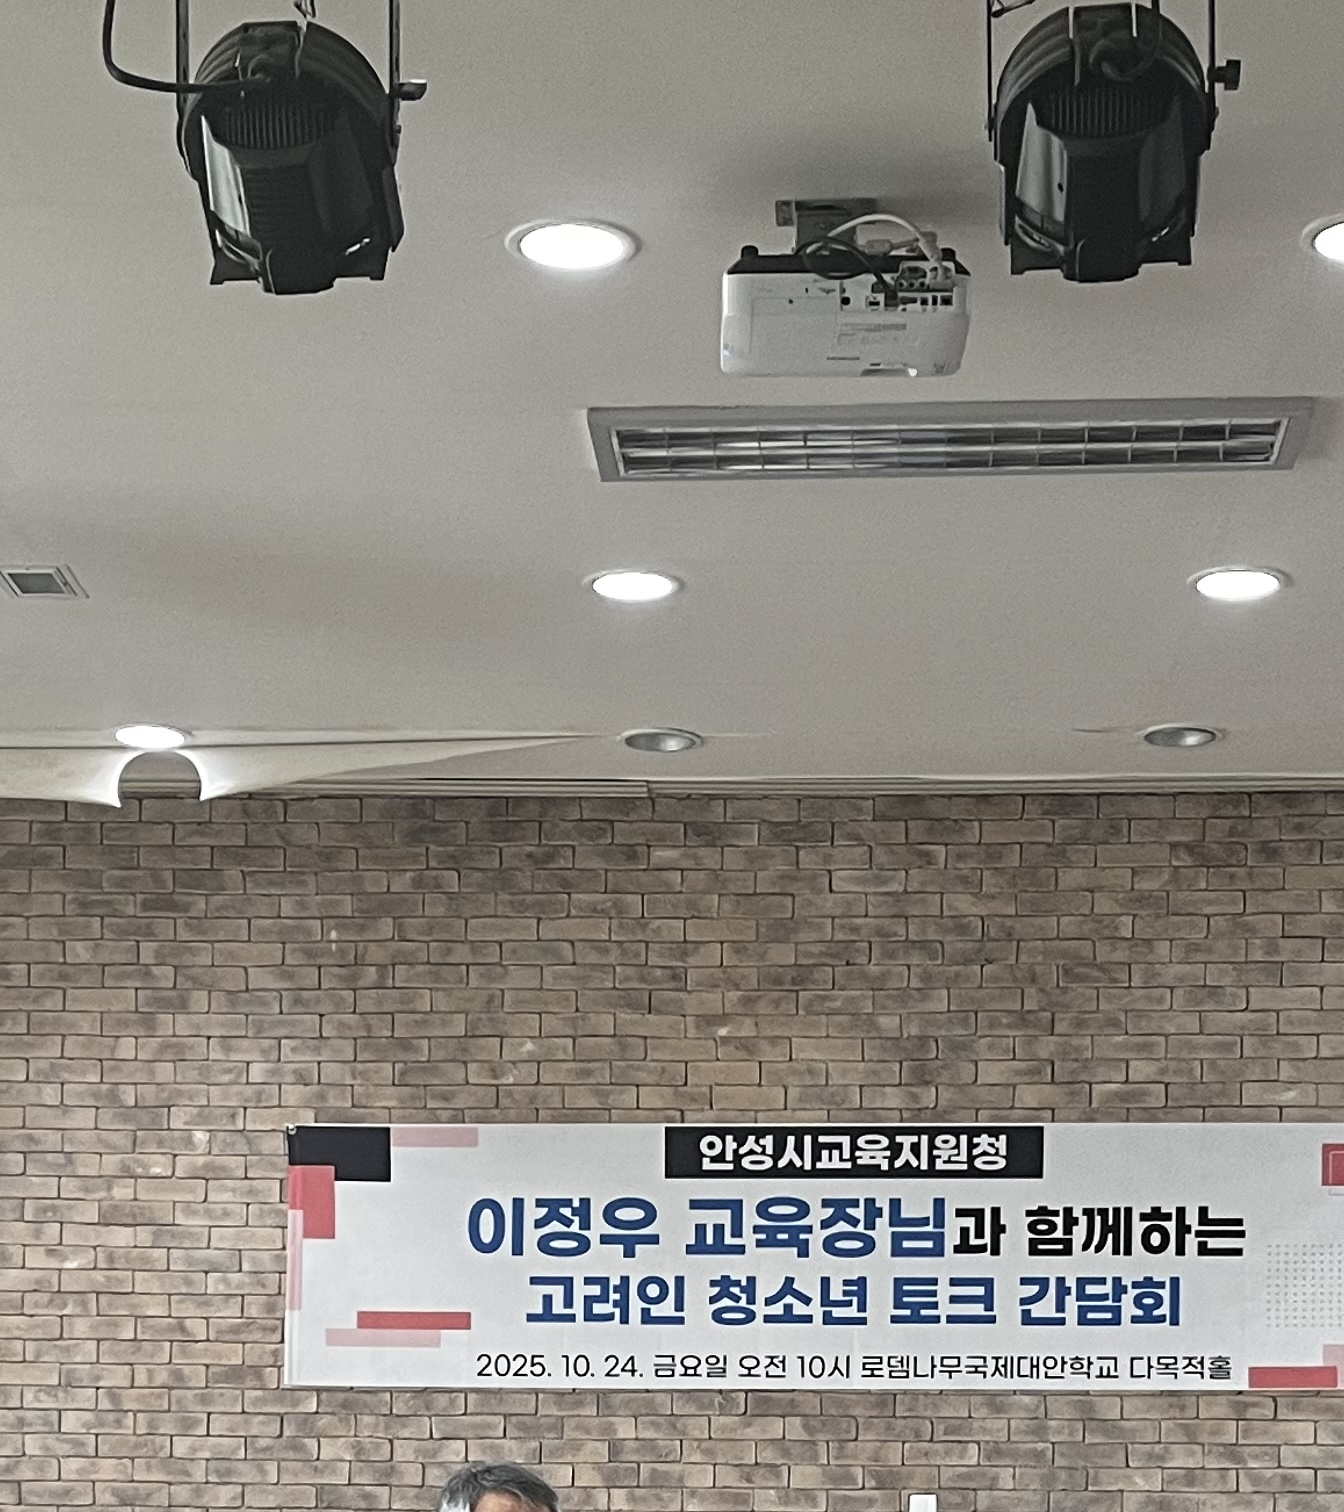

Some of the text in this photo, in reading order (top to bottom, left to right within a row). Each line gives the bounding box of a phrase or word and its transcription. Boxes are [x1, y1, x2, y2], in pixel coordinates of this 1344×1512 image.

[699, 1133, 1007, 1171] 안성시교육지원청
[468, 1196, 1247, 1258] 이정우 교육장님과 함께하는
[526, 1274, 1181, 1327] 고려인 청소년 토크 간담회
[476, 1353, 1233, 1380] 2025. 10. 24. 금요일 오전 10시 로뎀나무국제대안학교 다목적홀
